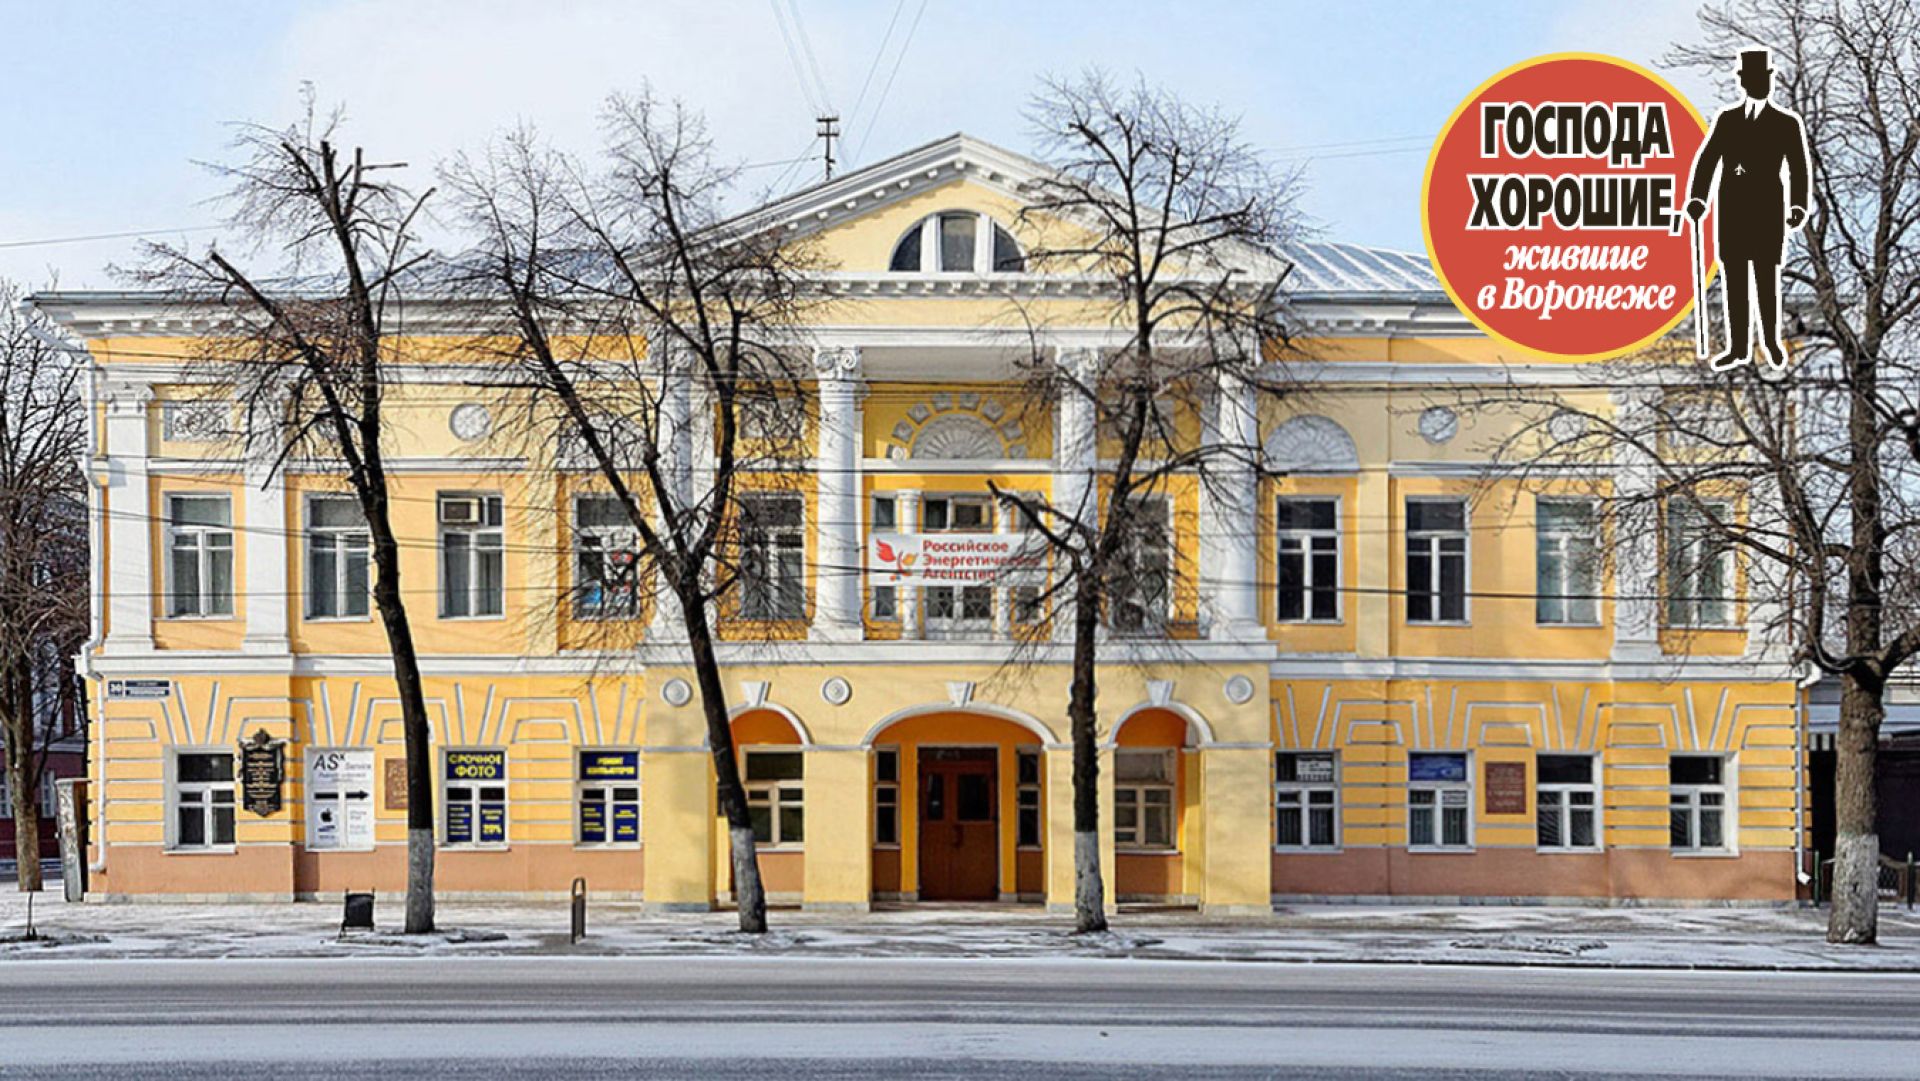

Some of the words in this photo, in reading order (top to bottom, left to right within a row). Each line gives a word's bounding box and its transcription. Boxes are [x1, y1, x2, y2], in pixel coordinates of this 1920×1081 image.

[922, 540, 1009, 552] Российское
[448, 754, 502, 765] СРОЧНОЕ
[455, 765, 497, 778] ФОТО
